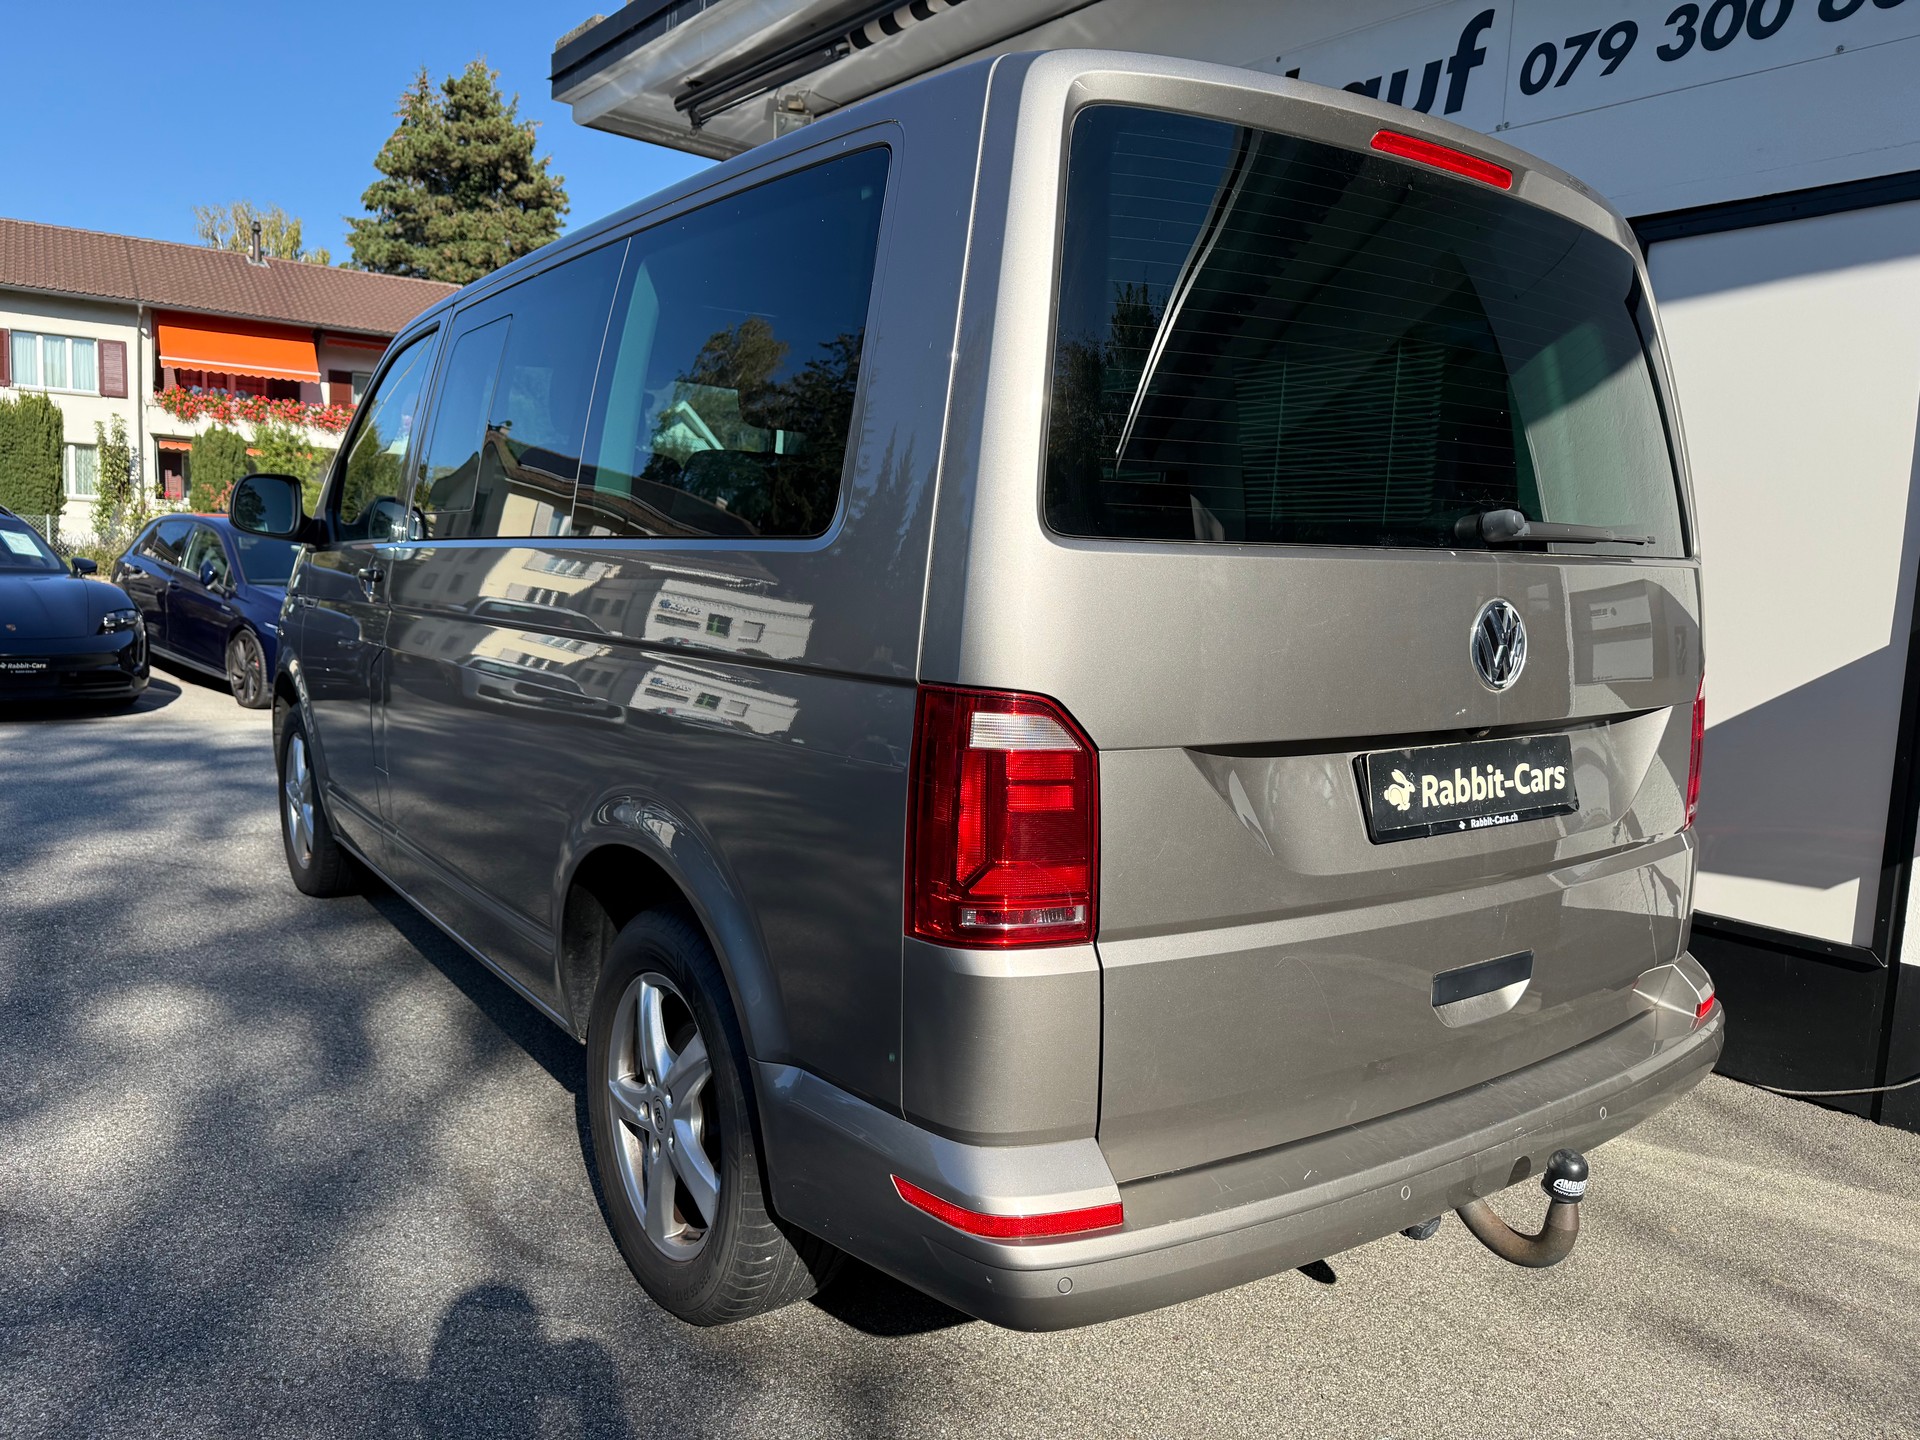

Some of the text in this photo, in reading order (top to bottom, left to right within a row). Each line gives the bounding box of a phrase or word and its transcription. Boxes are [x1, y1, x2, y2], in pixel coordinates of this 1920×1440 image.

[1519, 20, 1639, 96] 079
[1656, 0, 1795, 62] 300
[1421, 762, 1566, 808] Rabbit-Cars
[1470, 812, 1519, 828] Rabbit-Cars.ch
